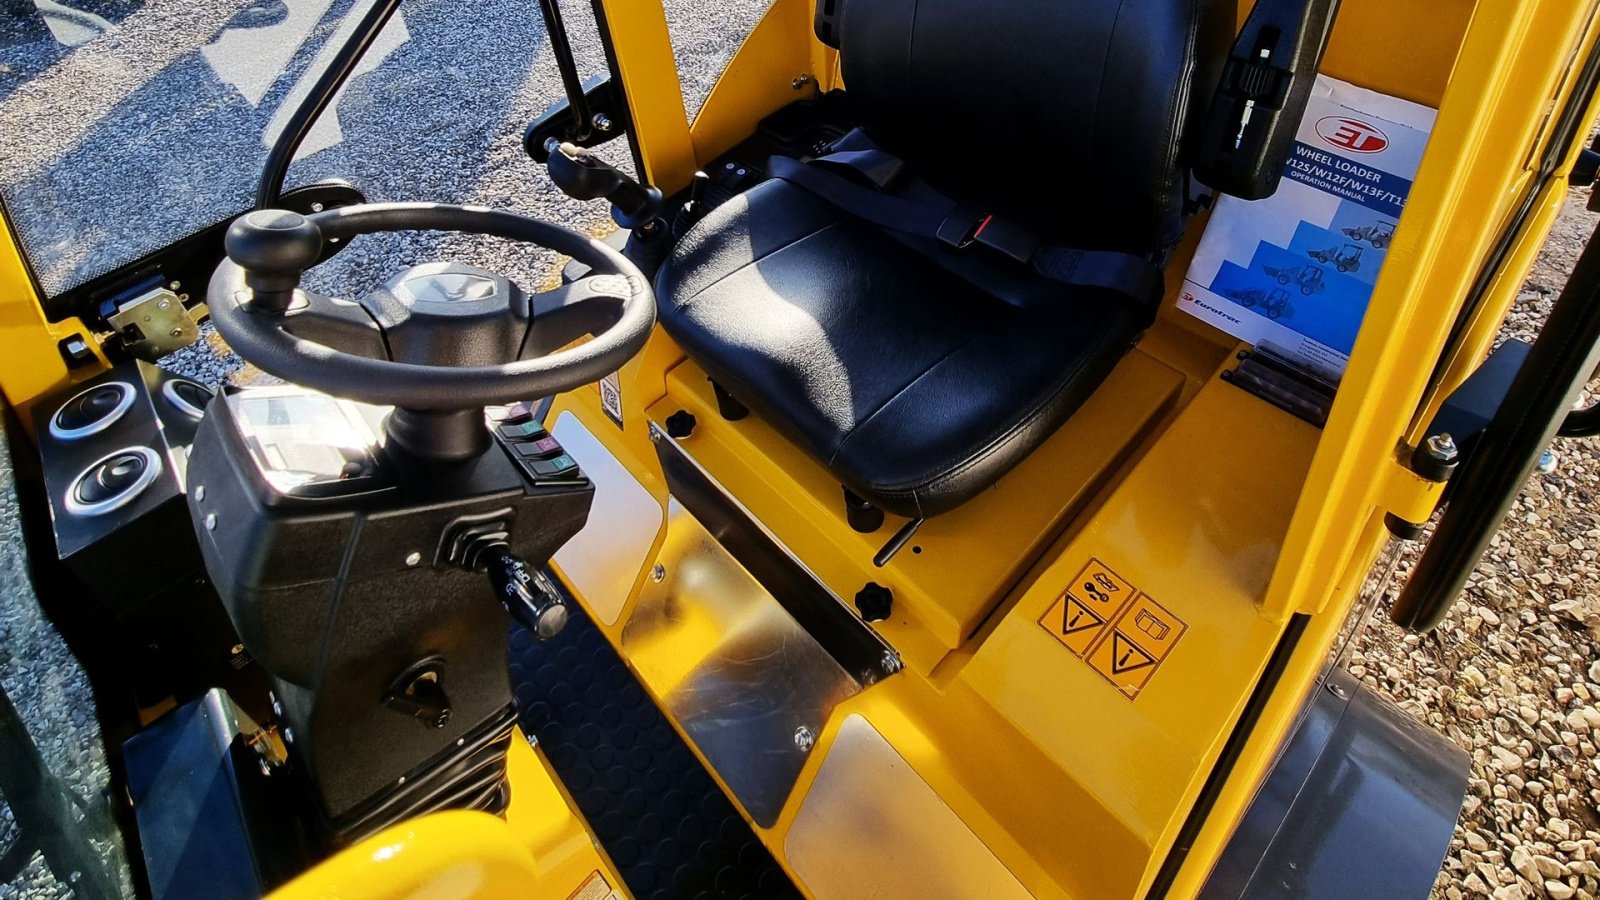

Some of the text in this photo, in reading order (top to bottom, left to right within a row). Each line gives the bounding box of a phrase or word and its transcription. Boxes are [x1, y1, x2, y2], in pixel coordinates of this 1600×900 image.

[1296, 146, 1381, 183] WHEEL LOADER
[1291, 170, 1366, 202] OPERATION MANUAL
[1194, 299, 1241, 324] Eurotrac
